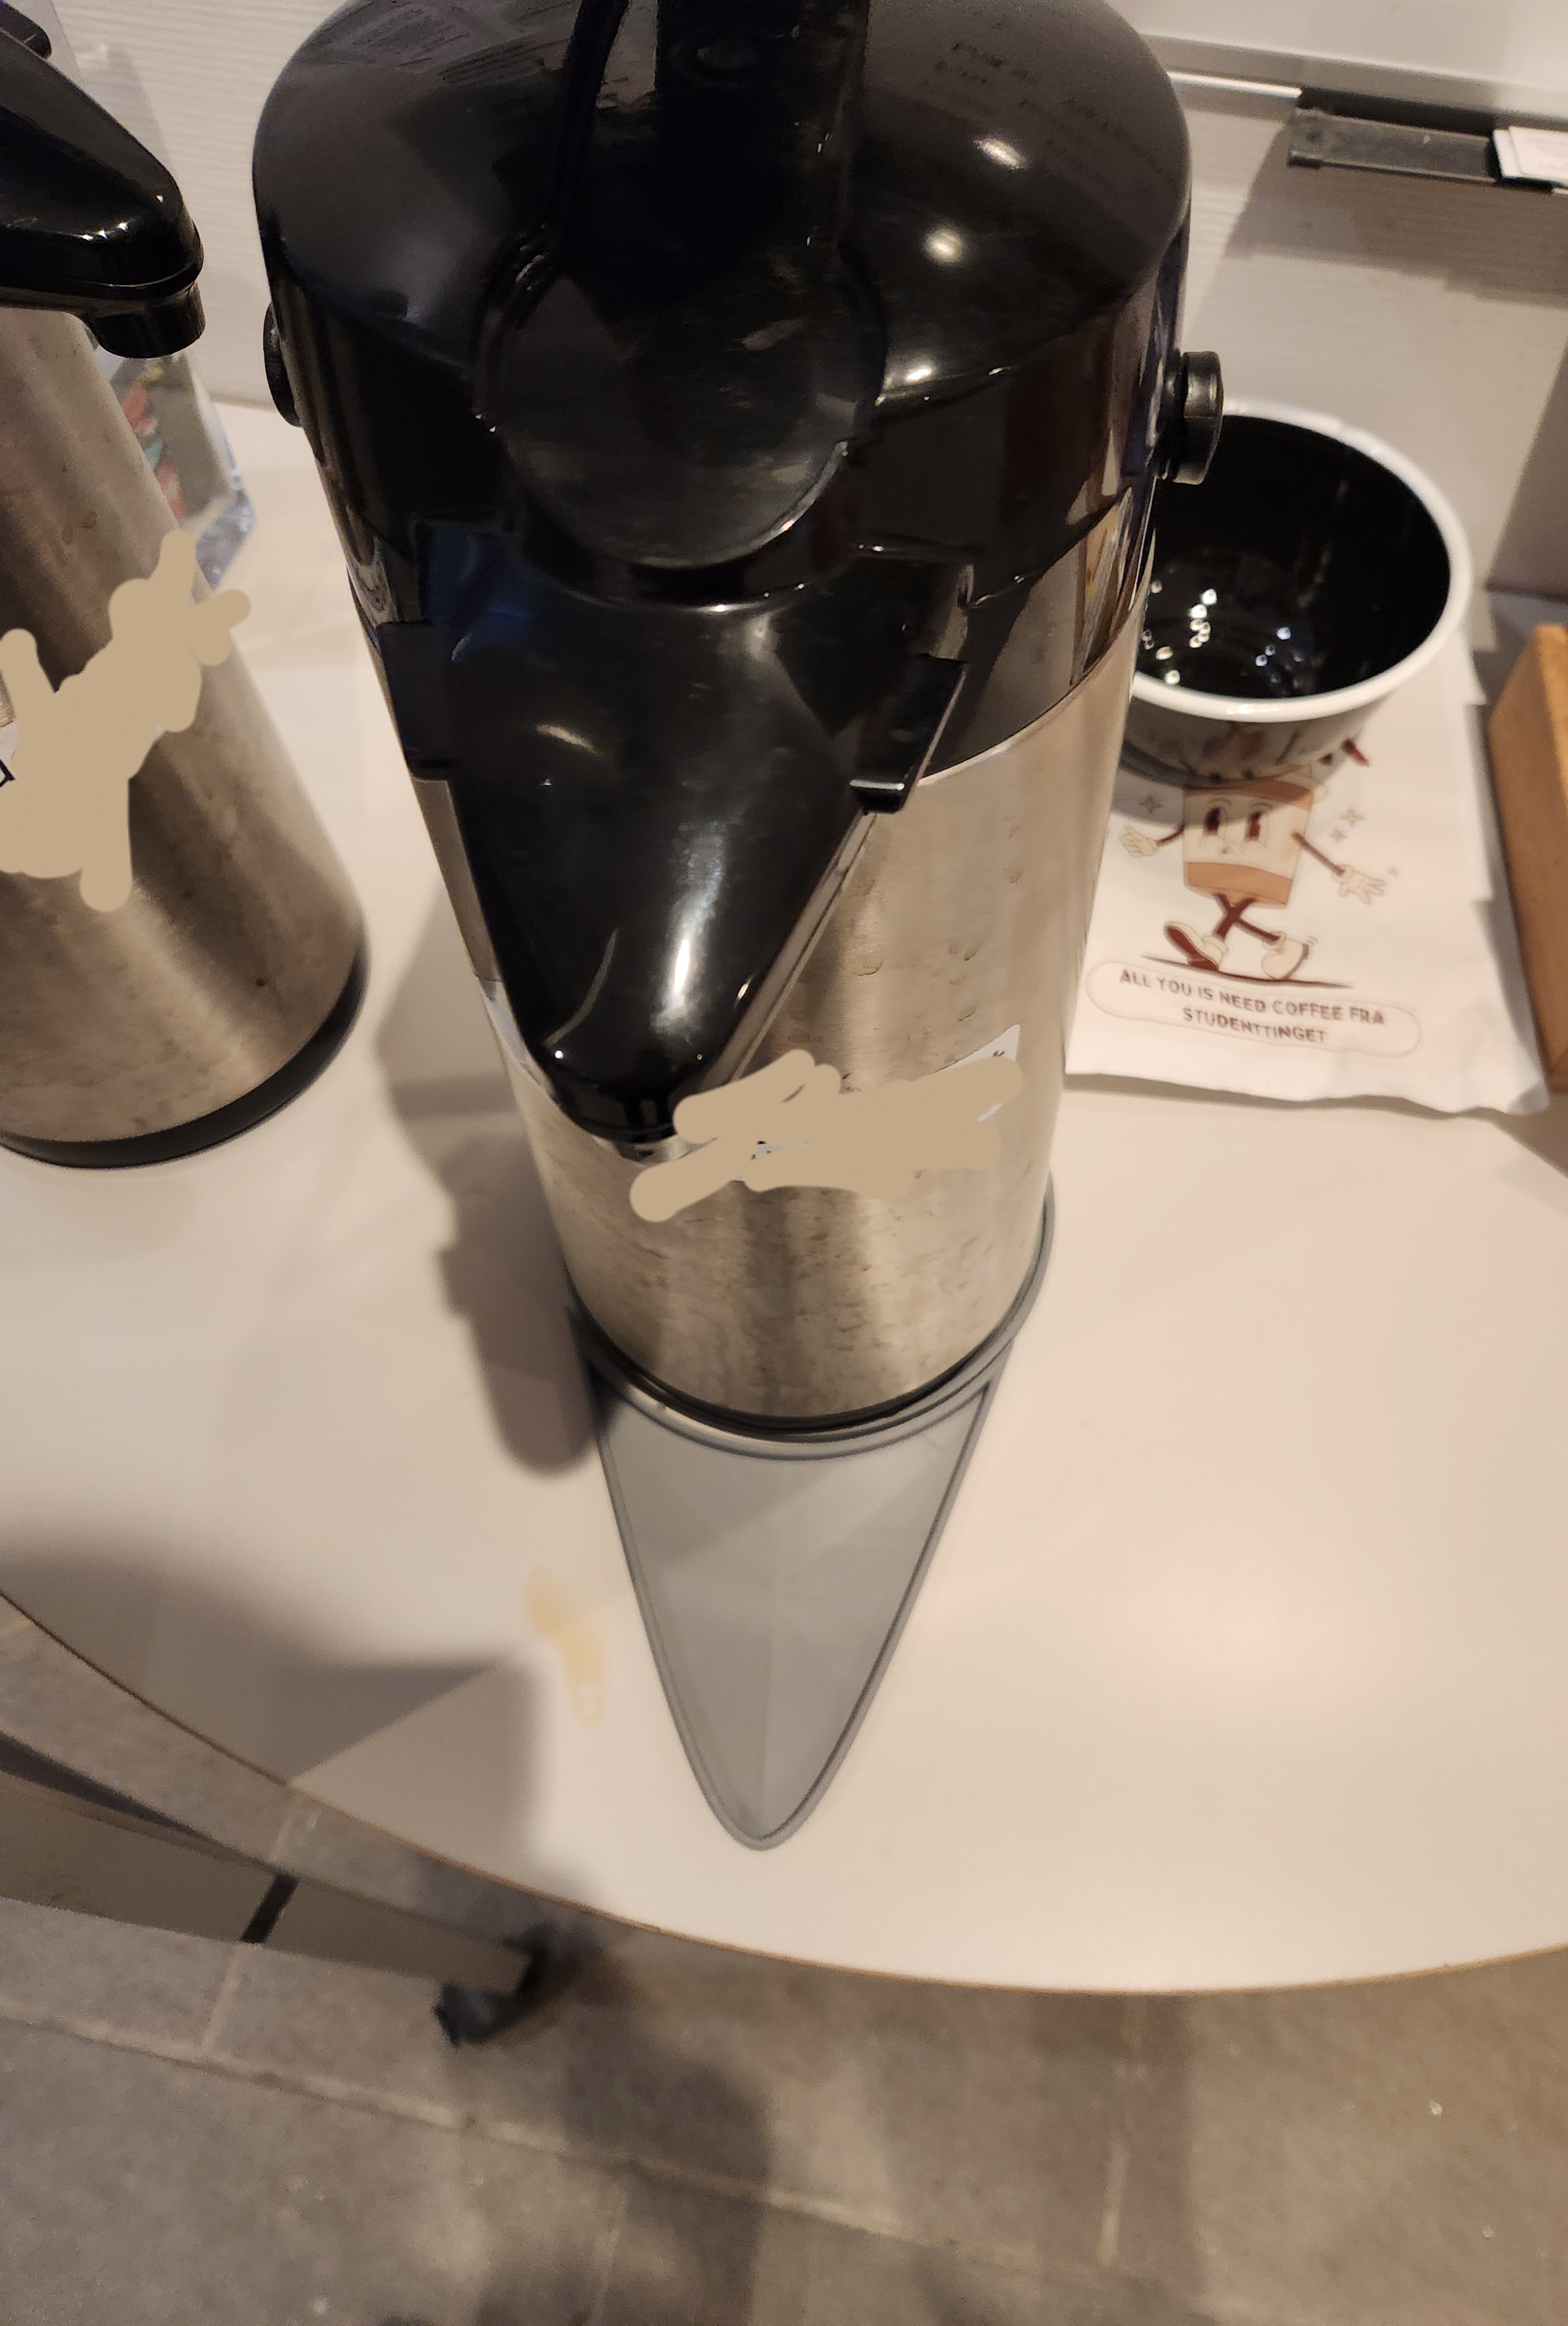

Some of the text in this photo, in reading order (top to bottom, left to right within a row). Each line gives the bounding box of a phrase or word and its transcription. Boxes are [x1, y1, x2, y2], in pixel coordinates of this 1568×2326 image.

[1120, 969, 1385, 1025] ALL YOU IS NEED COFFEE FRA
[1183, 1007, 1326, 1044] STUDENTTINGET
